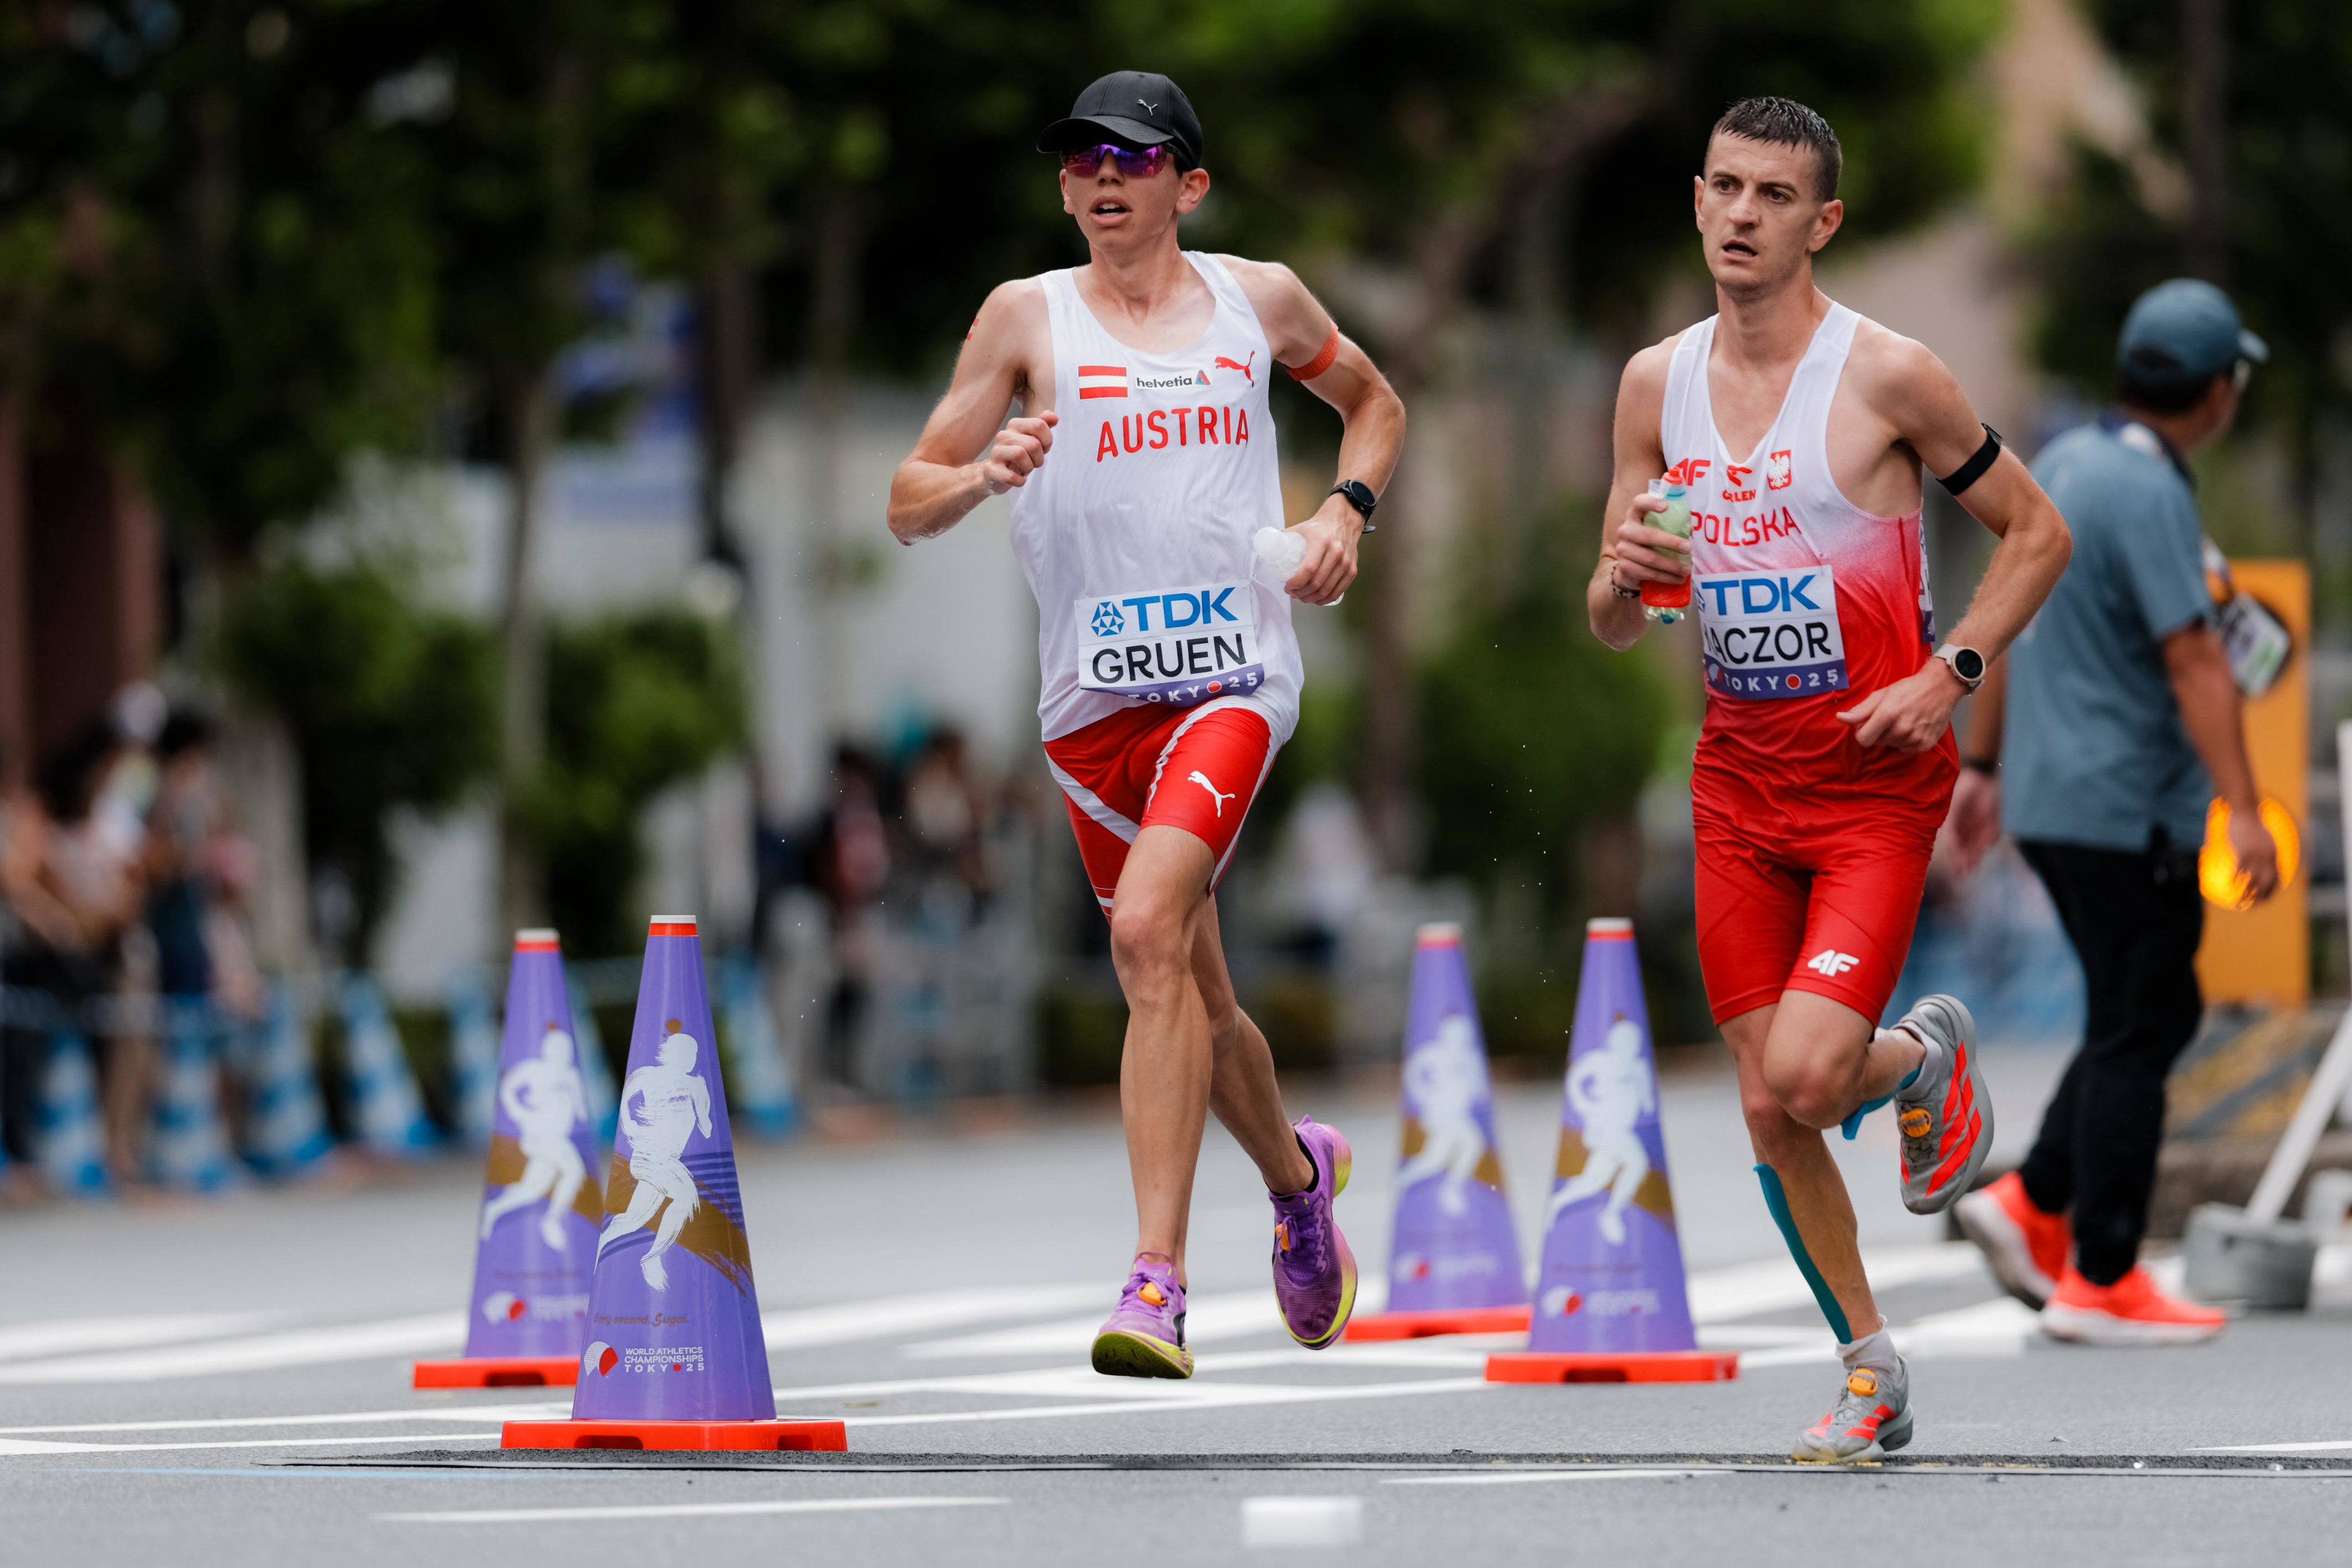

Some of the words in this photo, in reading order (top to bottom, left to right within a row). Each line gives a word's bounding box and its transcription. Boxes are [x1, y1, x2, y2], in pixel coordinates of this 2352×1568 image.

[1137, 376, 1192, 388] helvetia
[1097, 406, 1249, 462] AUSTRIA
[1722, 489, 1756, 503] ORLEN
[1690, 506, 1802, 546] POLSKA
[1122, 586, 1239, 632] TDK
[1701, 574, 1821, 616] TDK
[1092, 634, 1247, 683] GRUEN
[1807, 949, 1860, 977] 4F
[624, 1354, 704, 1364] CHAMPIONSHIPS
[656, 1346, 704, 1355] ATHLETICS
